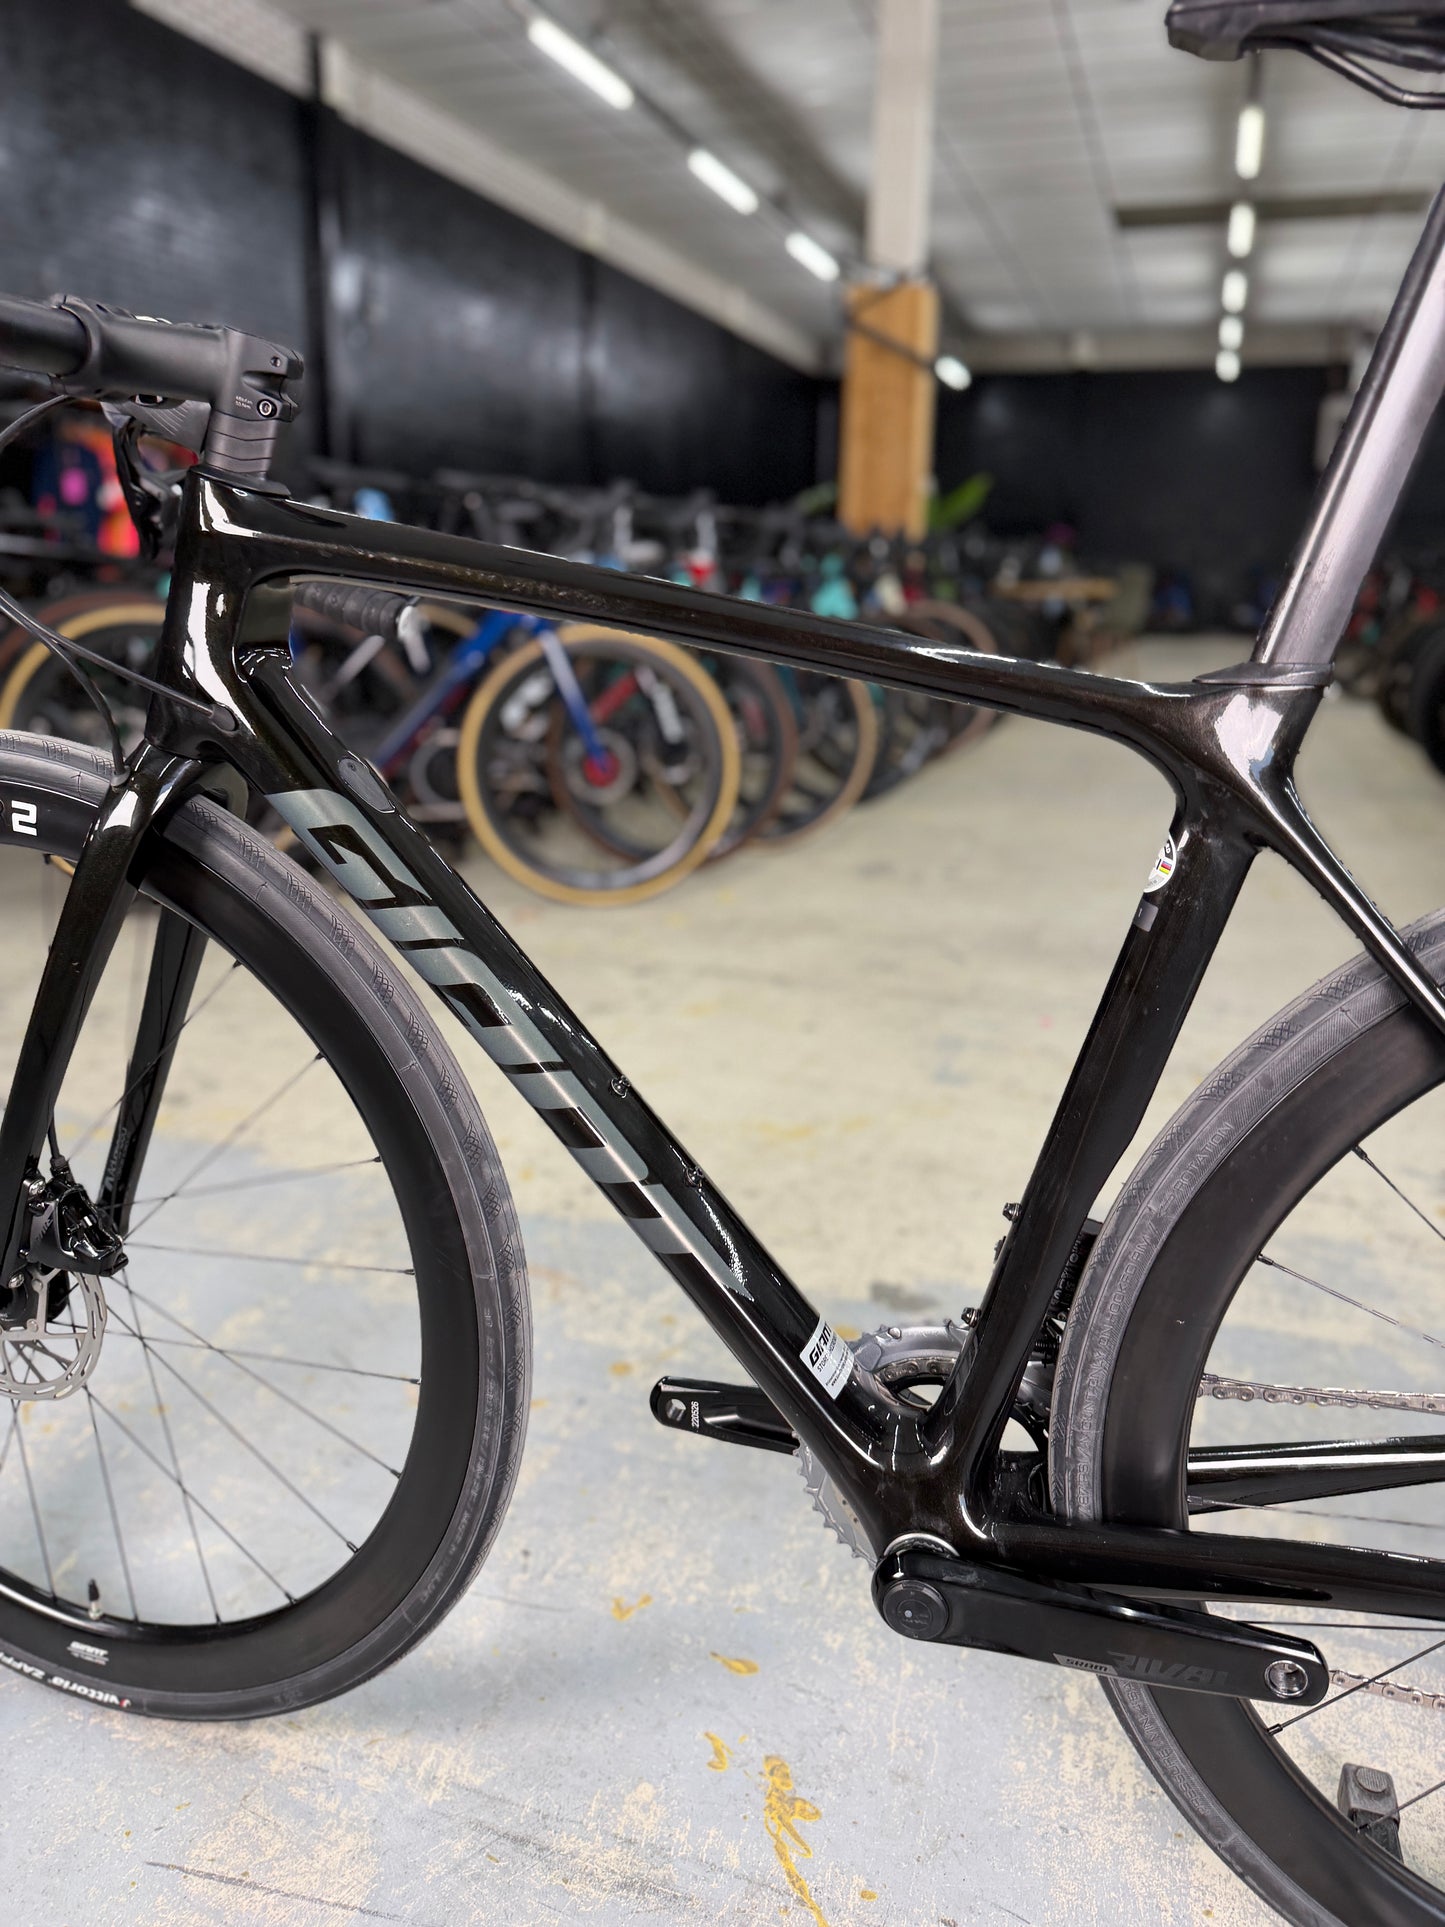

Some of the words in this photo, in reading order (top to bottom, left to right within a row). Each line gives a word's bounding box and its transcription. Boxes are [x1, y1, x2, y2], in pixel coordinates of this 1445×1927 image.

[11, 800, 38, 837] 2
[264, 787, 754, 1302] GIANT
[1173, 1121, 1235, 1192] ROTATION
